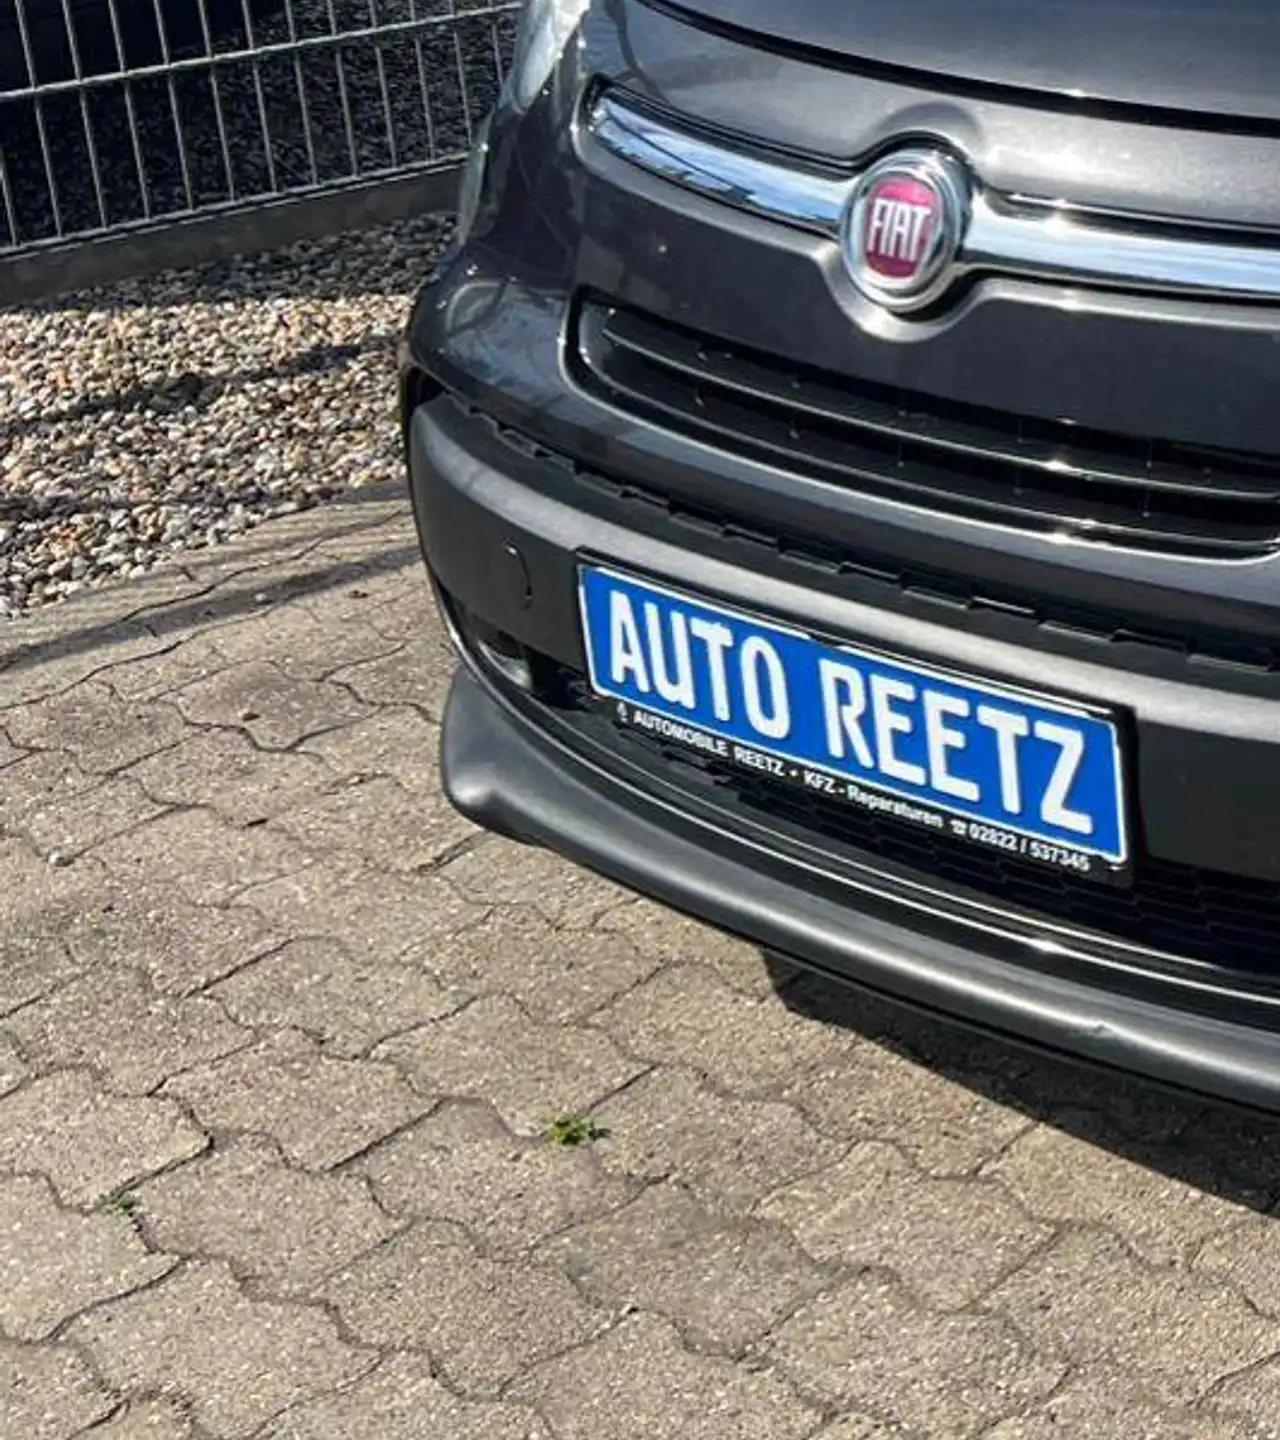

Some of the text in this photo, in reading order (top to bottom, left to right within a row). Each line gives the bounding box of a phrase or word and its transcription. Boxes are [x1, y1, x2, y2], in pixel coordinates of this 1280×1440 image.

[866, 196, 932, 262] FIAT
[607, 590, 1095, 835] AUTO REETZ
[633, 709, 729, 758] AUTOMOBILE
[733, 745, 786, 777] REETZ
